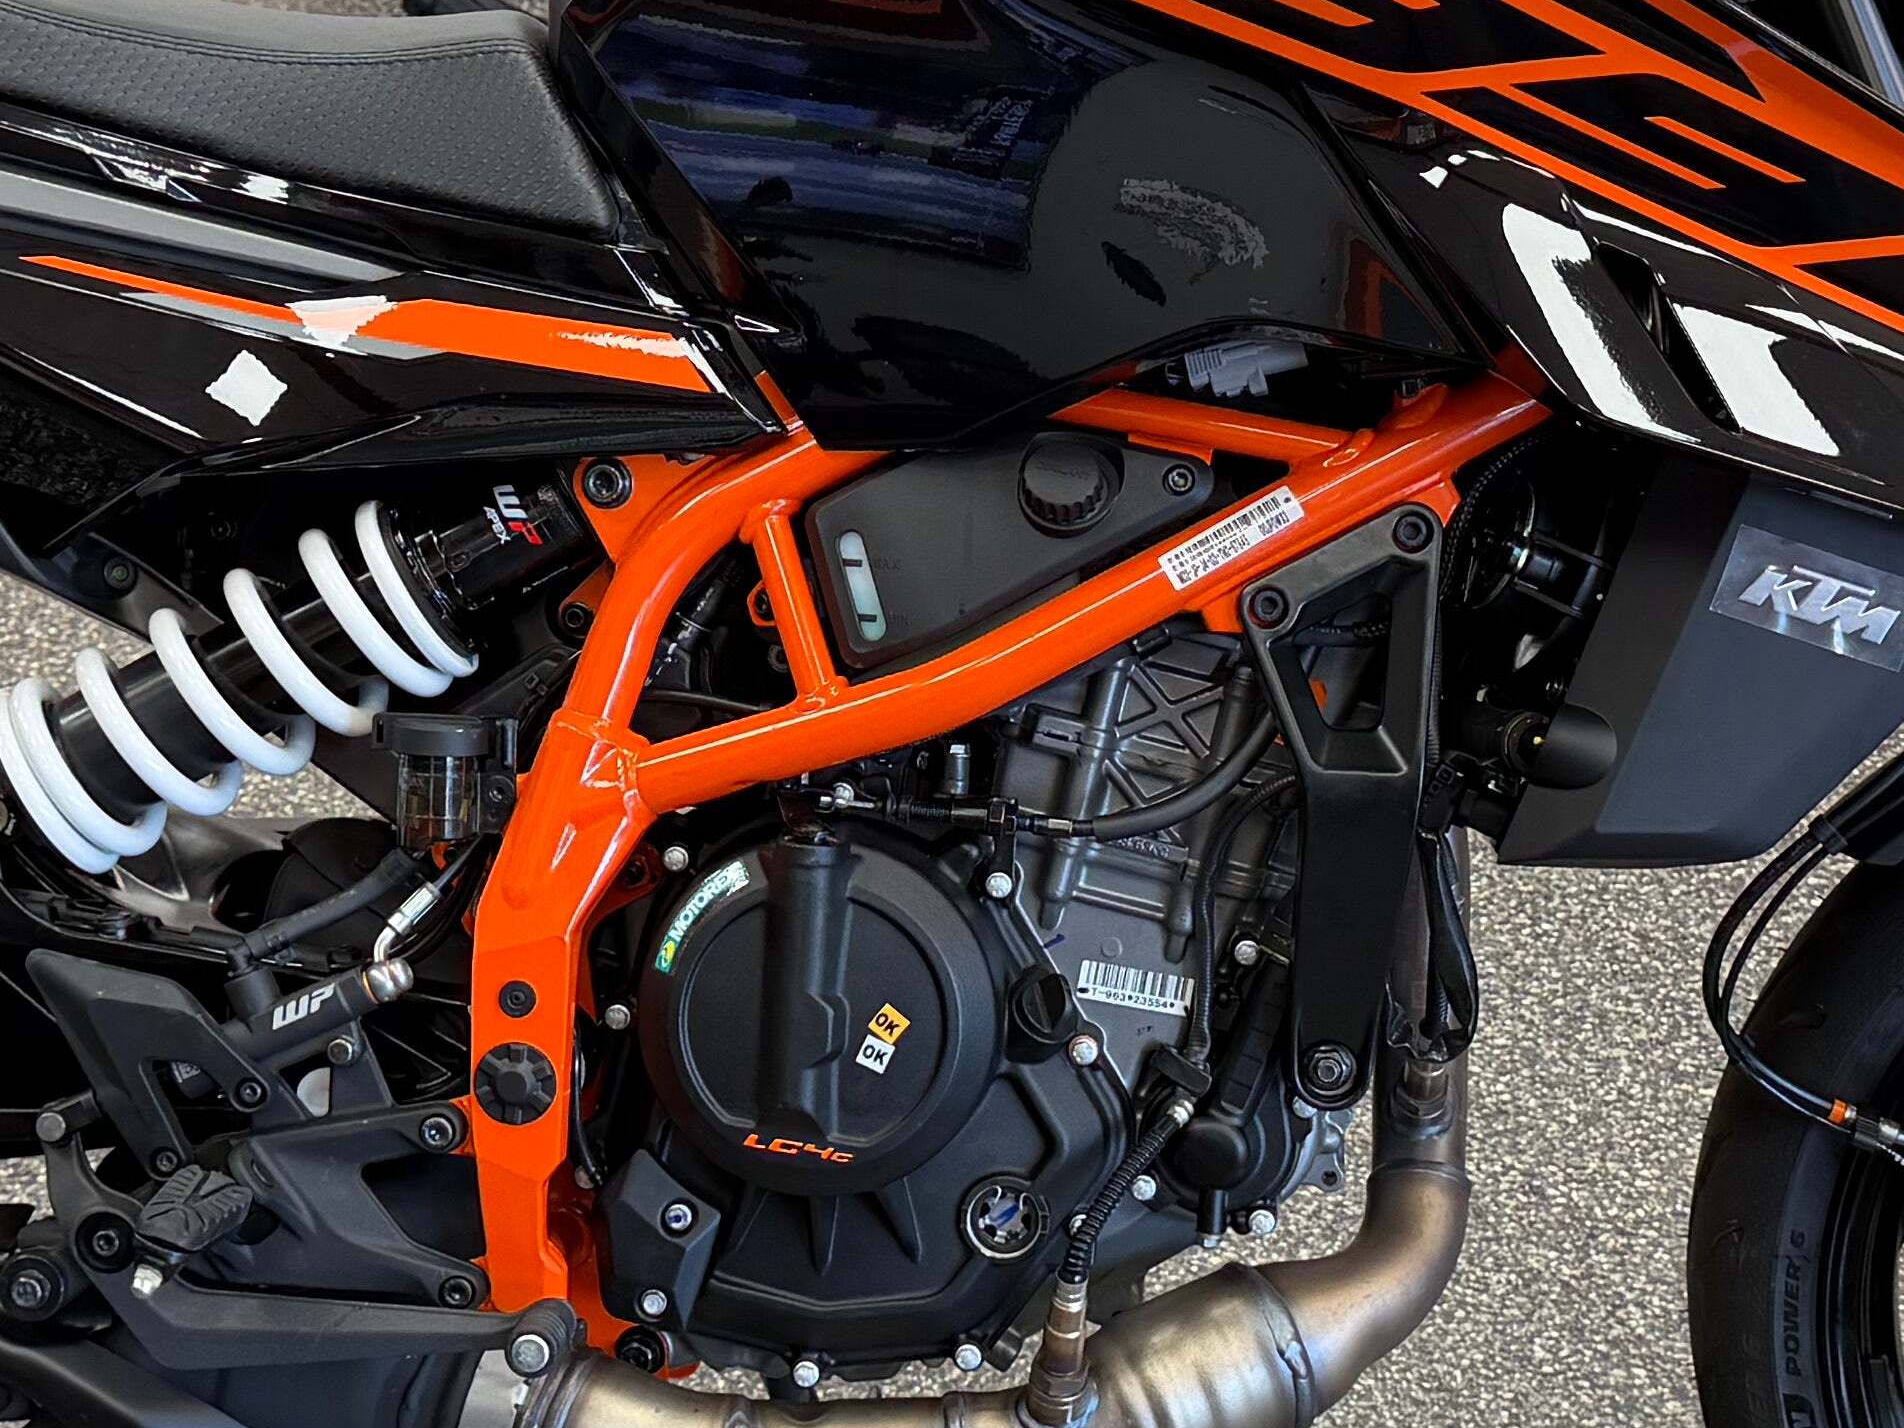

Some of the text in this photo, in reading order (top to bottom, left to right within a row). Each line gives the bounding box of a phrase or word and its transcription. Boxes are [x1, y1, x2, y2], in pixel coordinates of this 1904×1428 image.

[482, 506, 511, 545] APEX
[493, 484, 543, 546] WP
[1739, 565, 1902, 646] KTM
[272, 982, 335, 1031] WP
[874, 1012, 901, 1038] OK
[862, 1043, 889, 1068] OK
[1783, 1229, 1807, 1377] POWER 6
